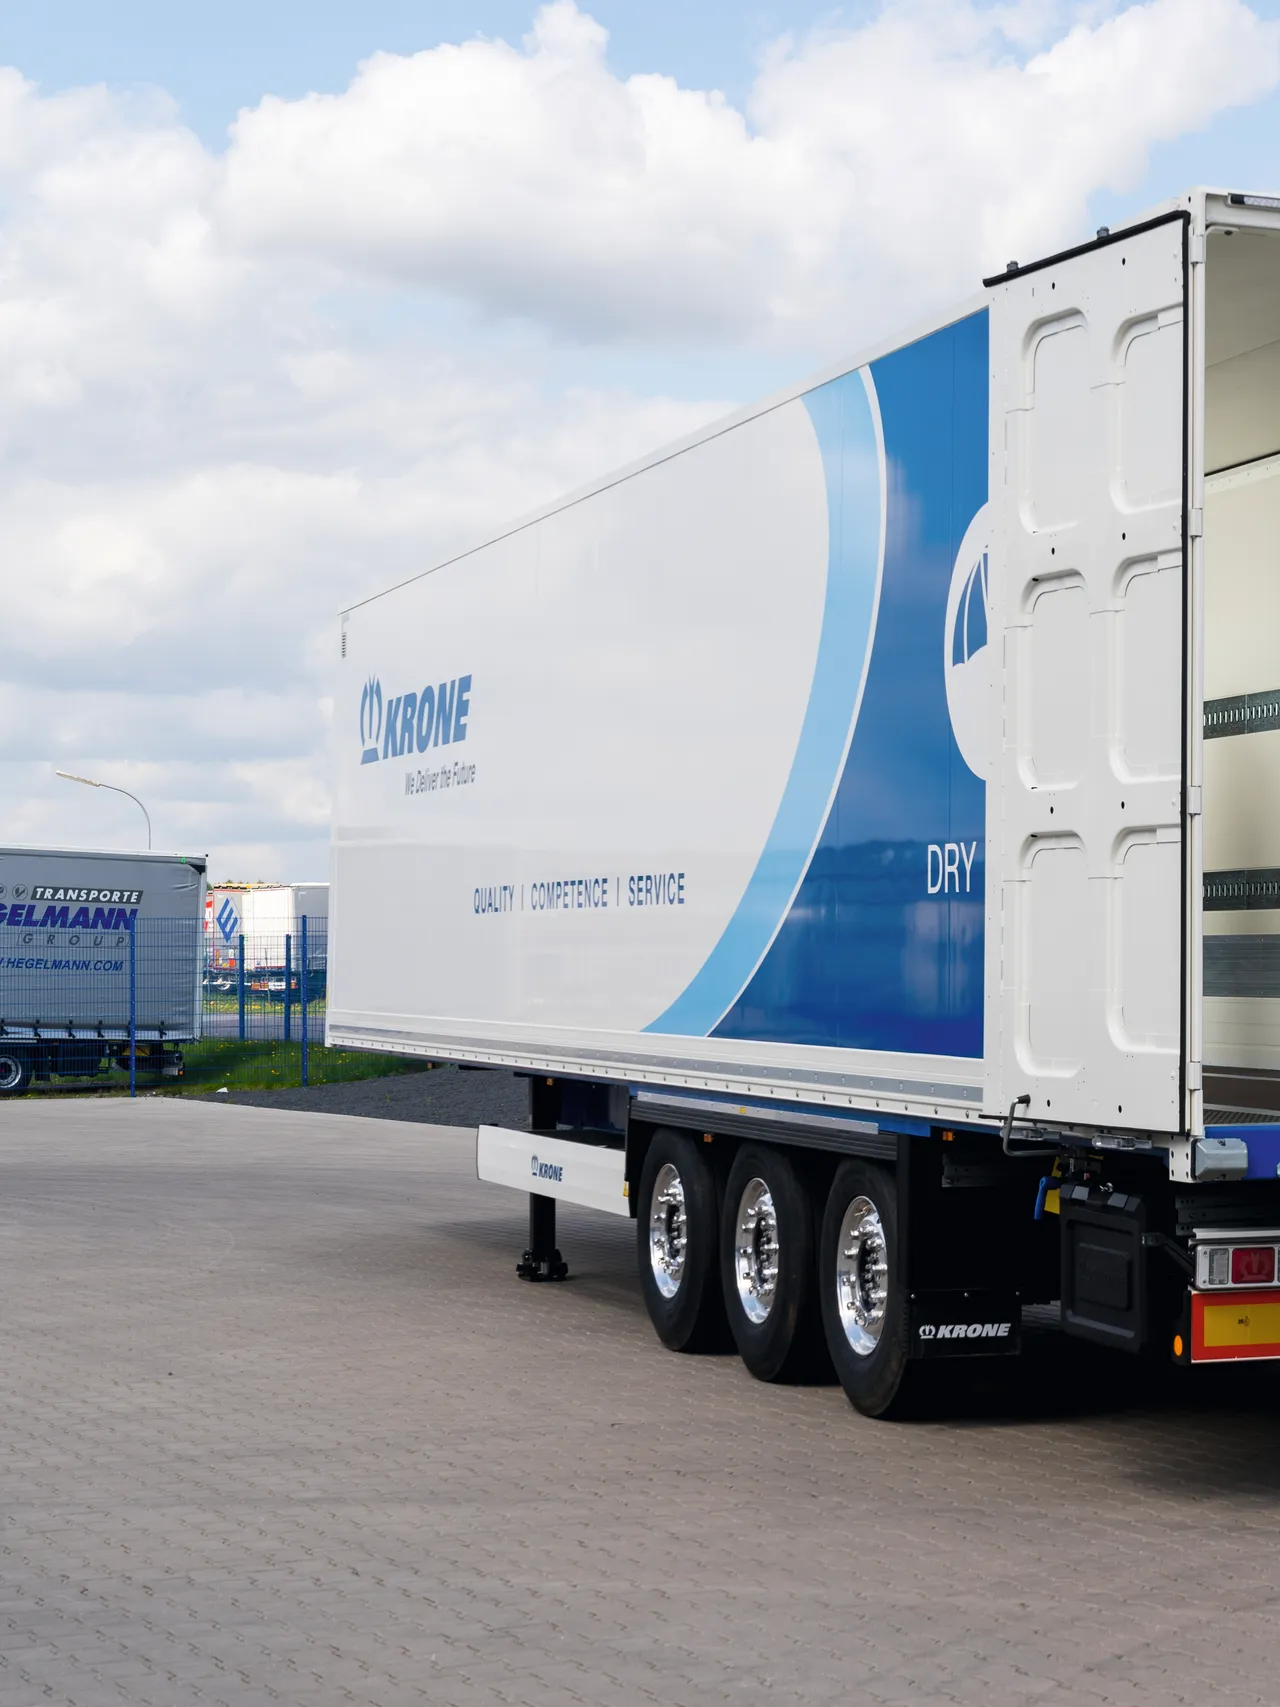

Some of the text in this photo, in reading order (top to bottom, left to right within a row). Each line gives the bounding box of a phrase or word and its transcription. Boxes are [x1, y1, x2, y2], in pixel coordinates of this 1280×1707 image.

[382, 674, 472, 760] KRONE
[416, 768, 439, 793] Deliver
[440, 764, 451, 788] the
[452, 761, 476, 786] Future
[927, 841, 977, 894] DRY
[35, 887, 139, 902] TRANSPORTE
[473, 872, 685, 914] QUALITY COMPETENCE SERVICE
[23, 933, 124, 947] GROUP
[0, 957, 123, 971] .HEGELMANN.COM
[538, 1162, 563, 1182] KRONE
[936, 1323, 1012, 1339] KRONE
